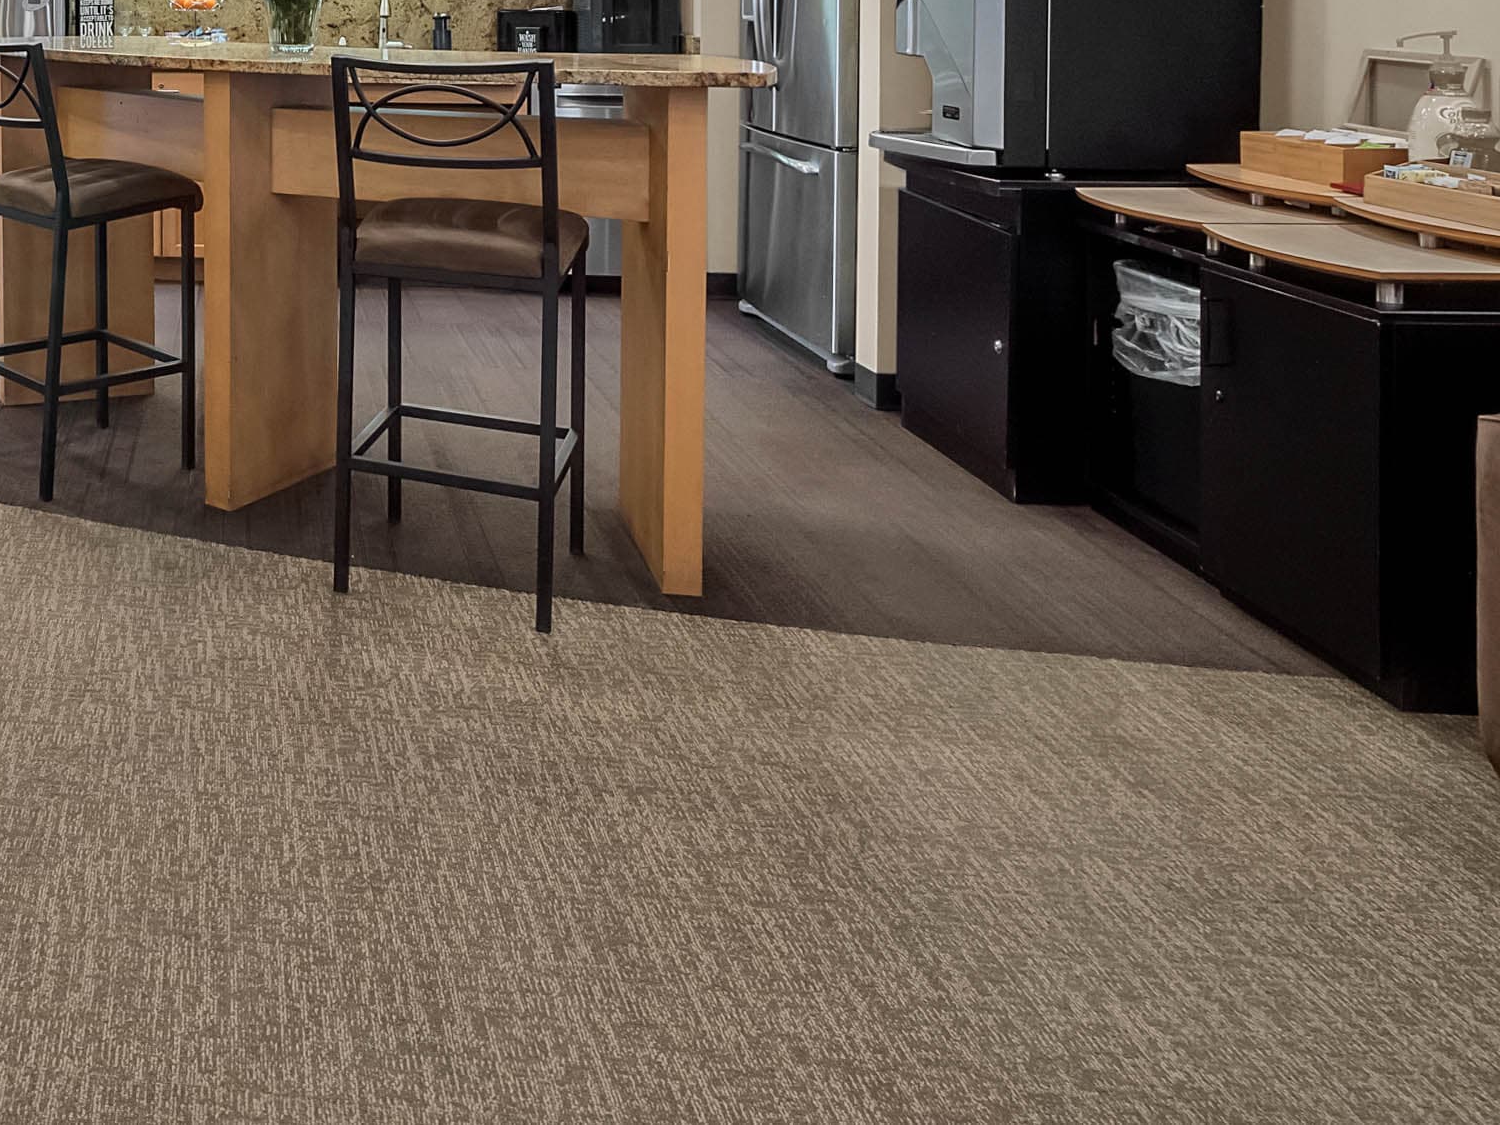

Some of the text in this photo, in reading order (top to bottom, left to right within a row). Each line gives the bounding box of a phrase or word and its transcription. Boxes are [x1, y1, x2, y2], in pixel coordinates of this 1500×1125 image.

[80, 6, 113, 15] UNTIL IT'S
[80, 22, 113, 36] DRINK
